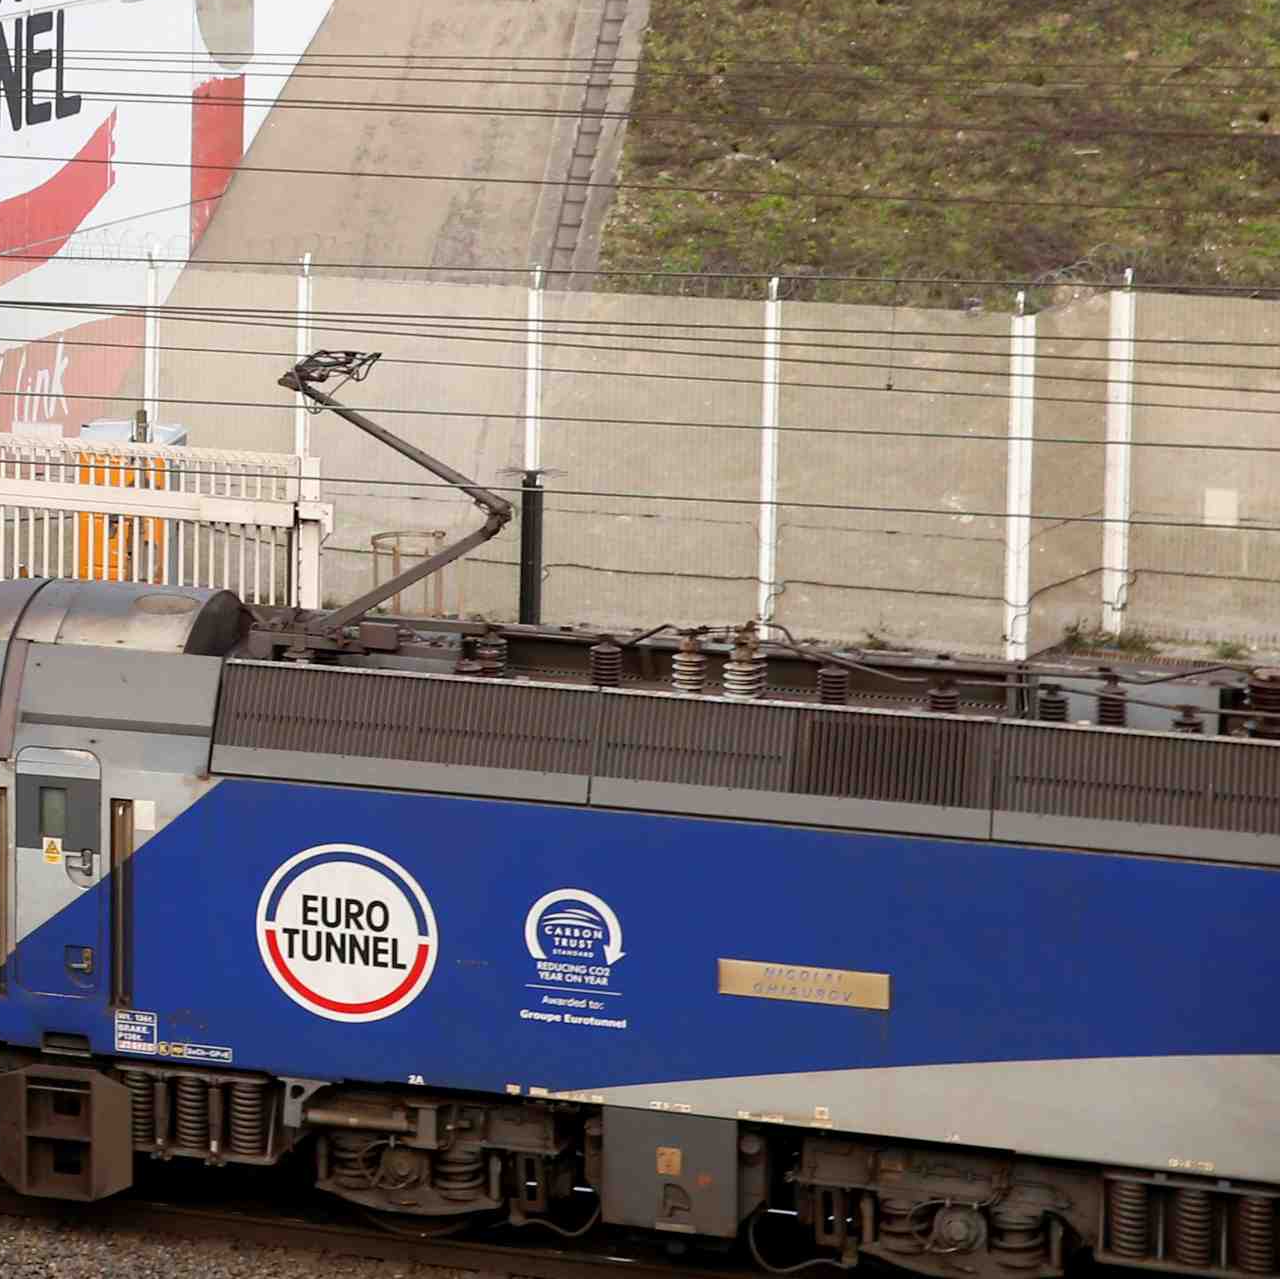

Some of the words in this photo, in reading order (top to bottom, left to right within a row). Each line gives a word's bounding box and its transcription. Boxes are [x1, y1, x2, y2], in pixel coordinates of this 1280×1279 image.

[14, 337, 69, 422] link
[301, 894, 390, 933] EURO
[544, 925, 603, 940] CARBON
[282, 927, 408, 970] TUNNEL
[554, 936, 593, 949] TRUST
[536, 960, 587, 974] REDUCING
[538, 970, 563, 981] YEAR
[564, 973, 582, 983] ON
[583, 975, 609, 986] YEAR
[520, 1008, 562, 1023] Groupe
